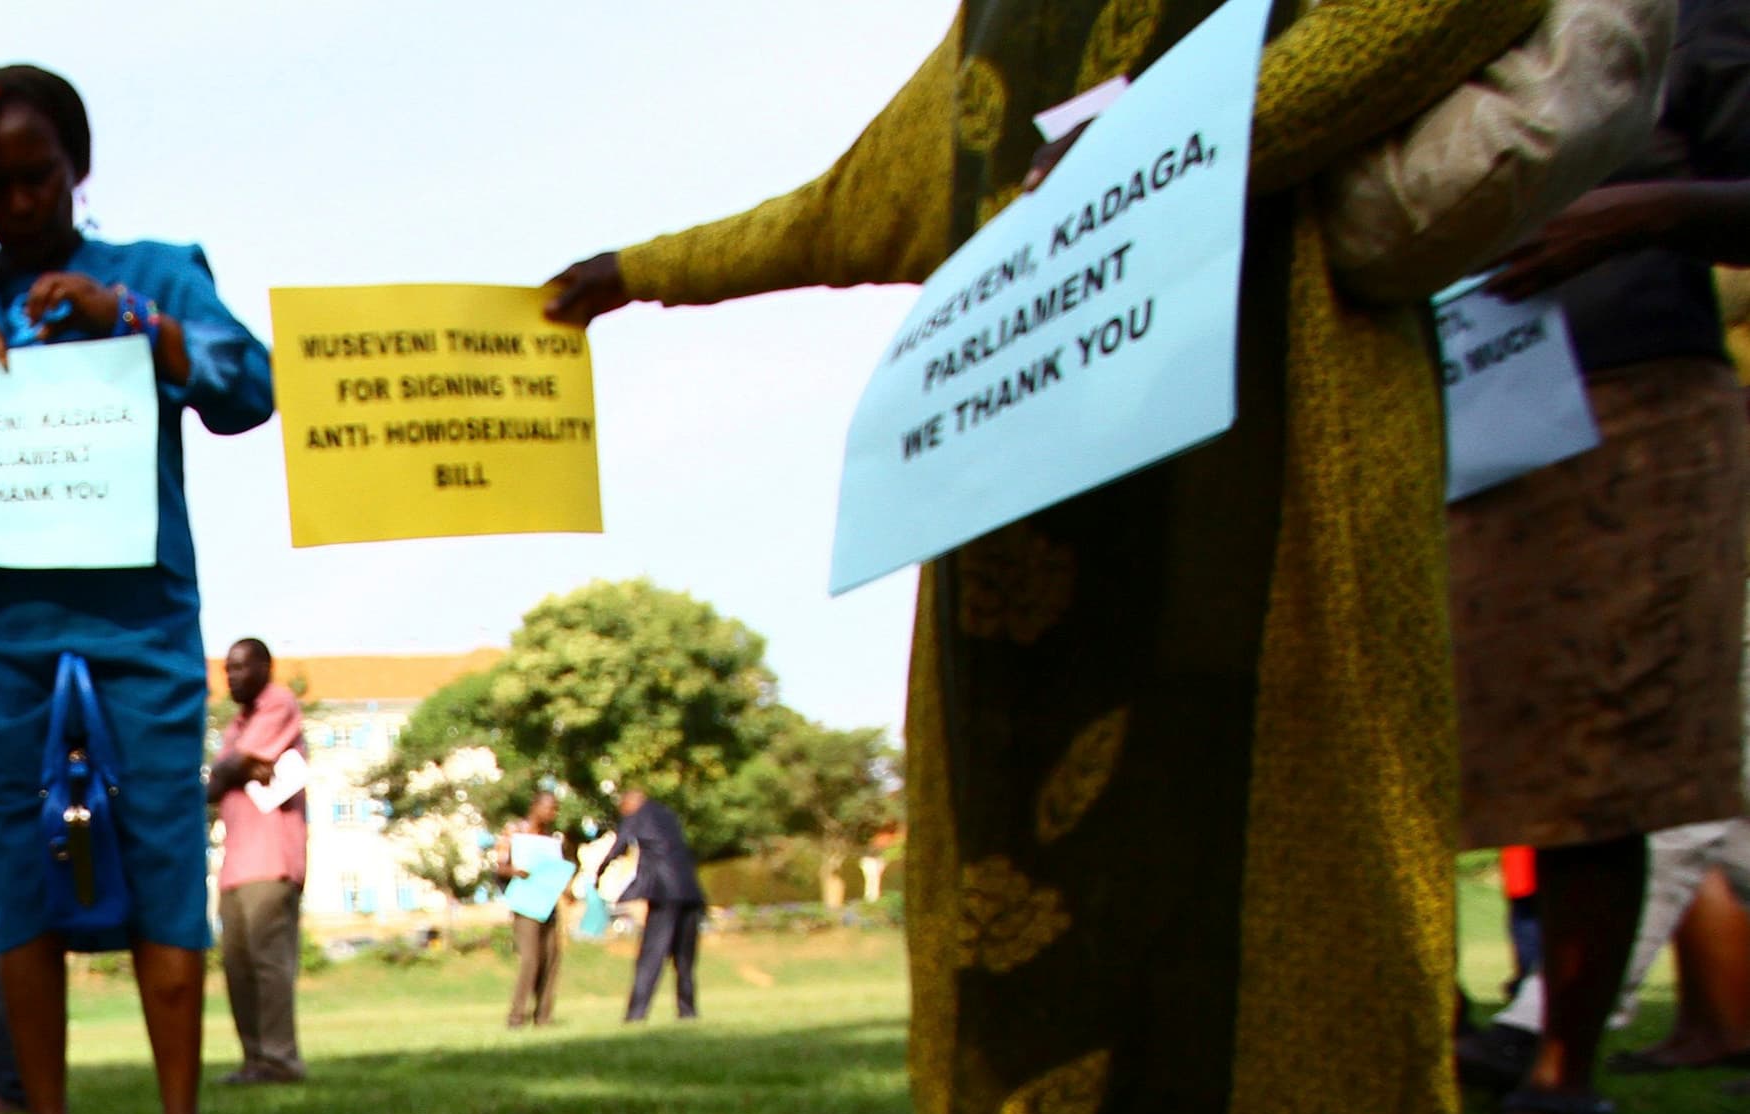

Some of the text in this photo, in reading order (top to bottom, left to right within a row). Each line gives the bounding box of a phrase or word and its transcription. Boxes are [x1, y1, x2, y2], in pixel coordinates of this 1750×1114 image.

[1048, 132, 1219, 257] KADAGA,
[922, 242, 1134, 391] PARLIAMENT
[300, 329, 583, 359] MUSEVENI THANK YOU
[337, 374, 559, 402] FOR SIGNING THE
[900, 299, 1155, 462] WE THANK YOU
[306, 418, 593, 449] ANTI- HOMOSEXUALITY
[434, 464, 490, 488] BILL
